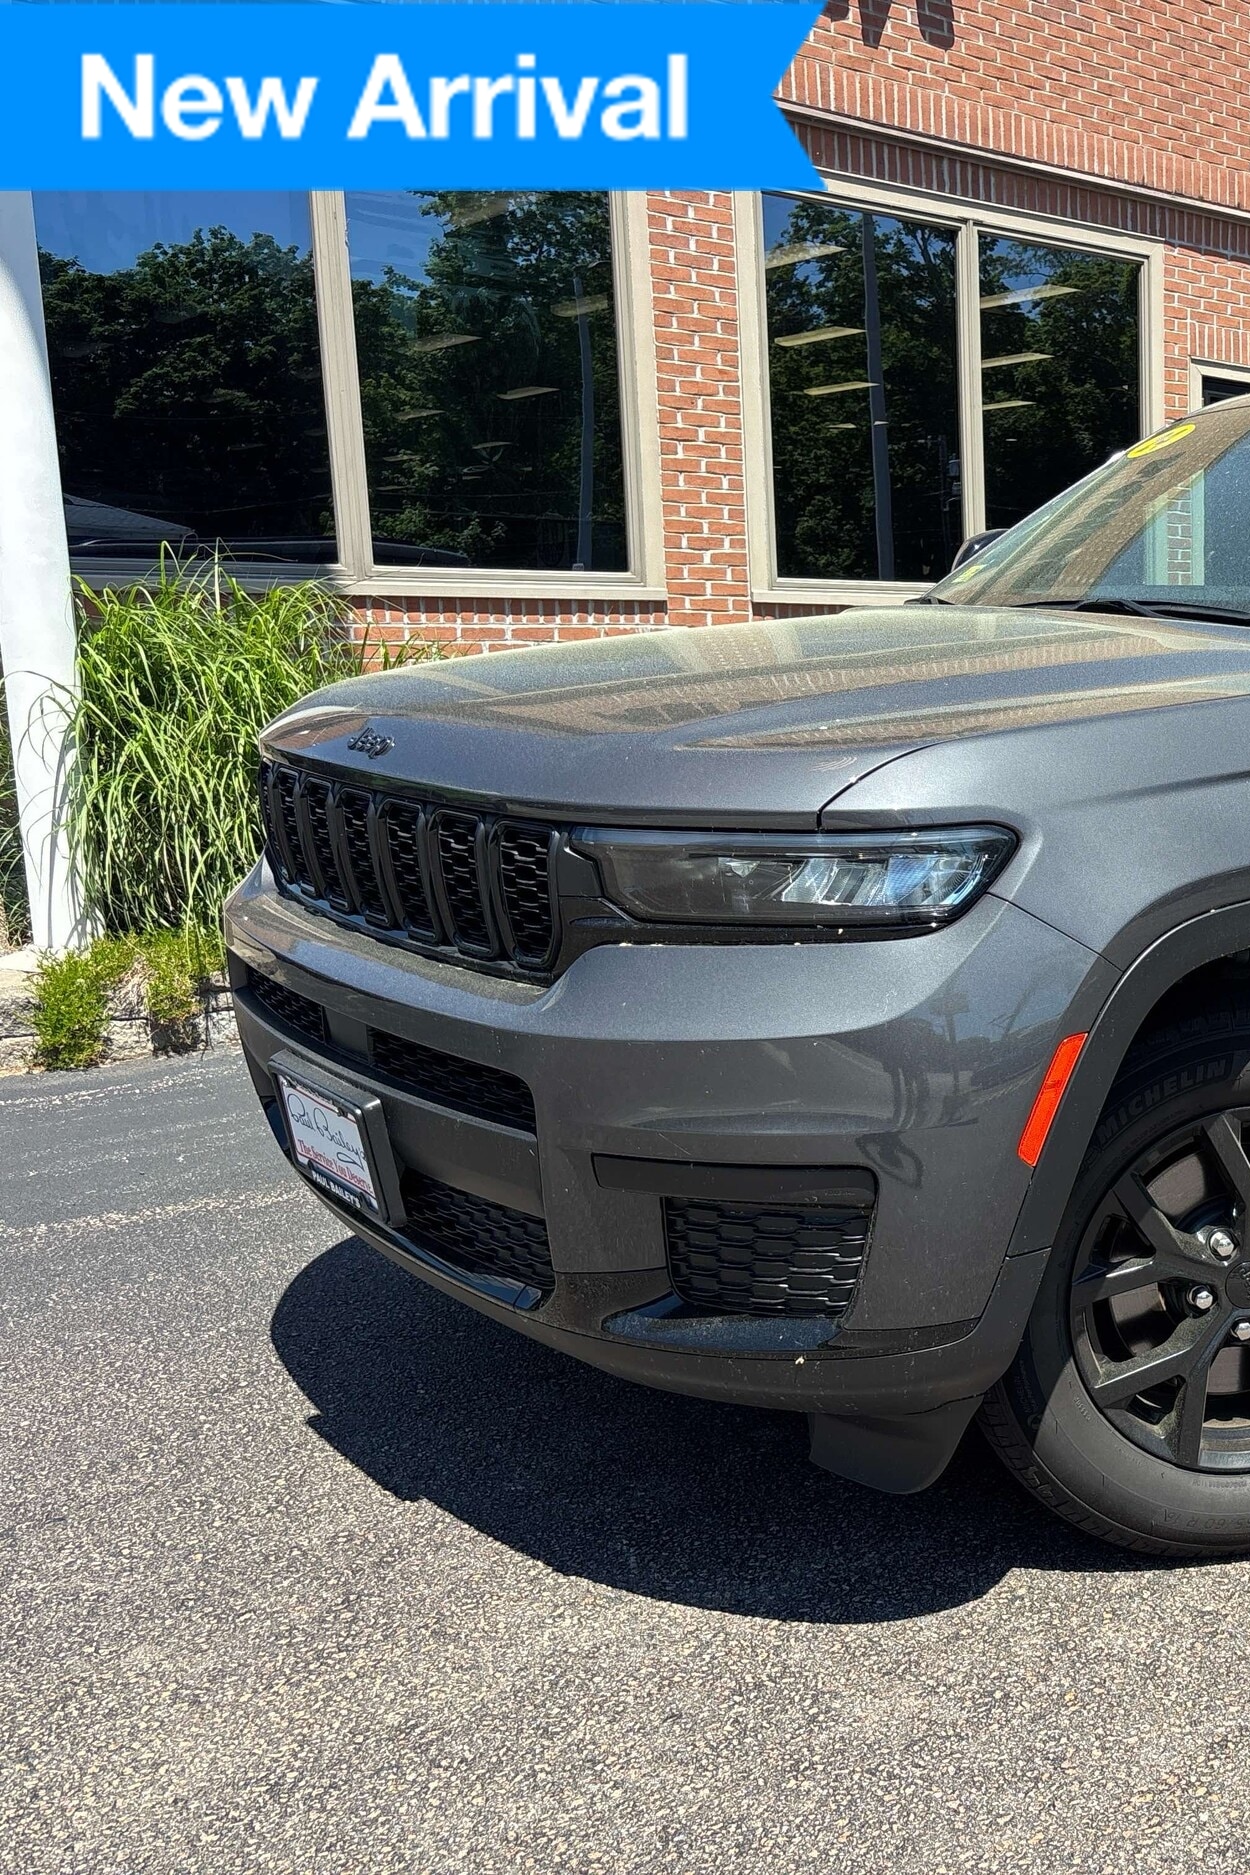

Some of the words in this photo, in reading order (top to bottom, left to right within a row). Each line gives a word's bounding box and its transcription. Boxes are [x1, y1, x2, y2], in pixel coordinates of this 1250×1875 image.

[347, 728, 396, 759] Jeep
[1100, 1058, 1227, 1143] MICHELIN
[312, 1169, 331, 1189] PAUL
